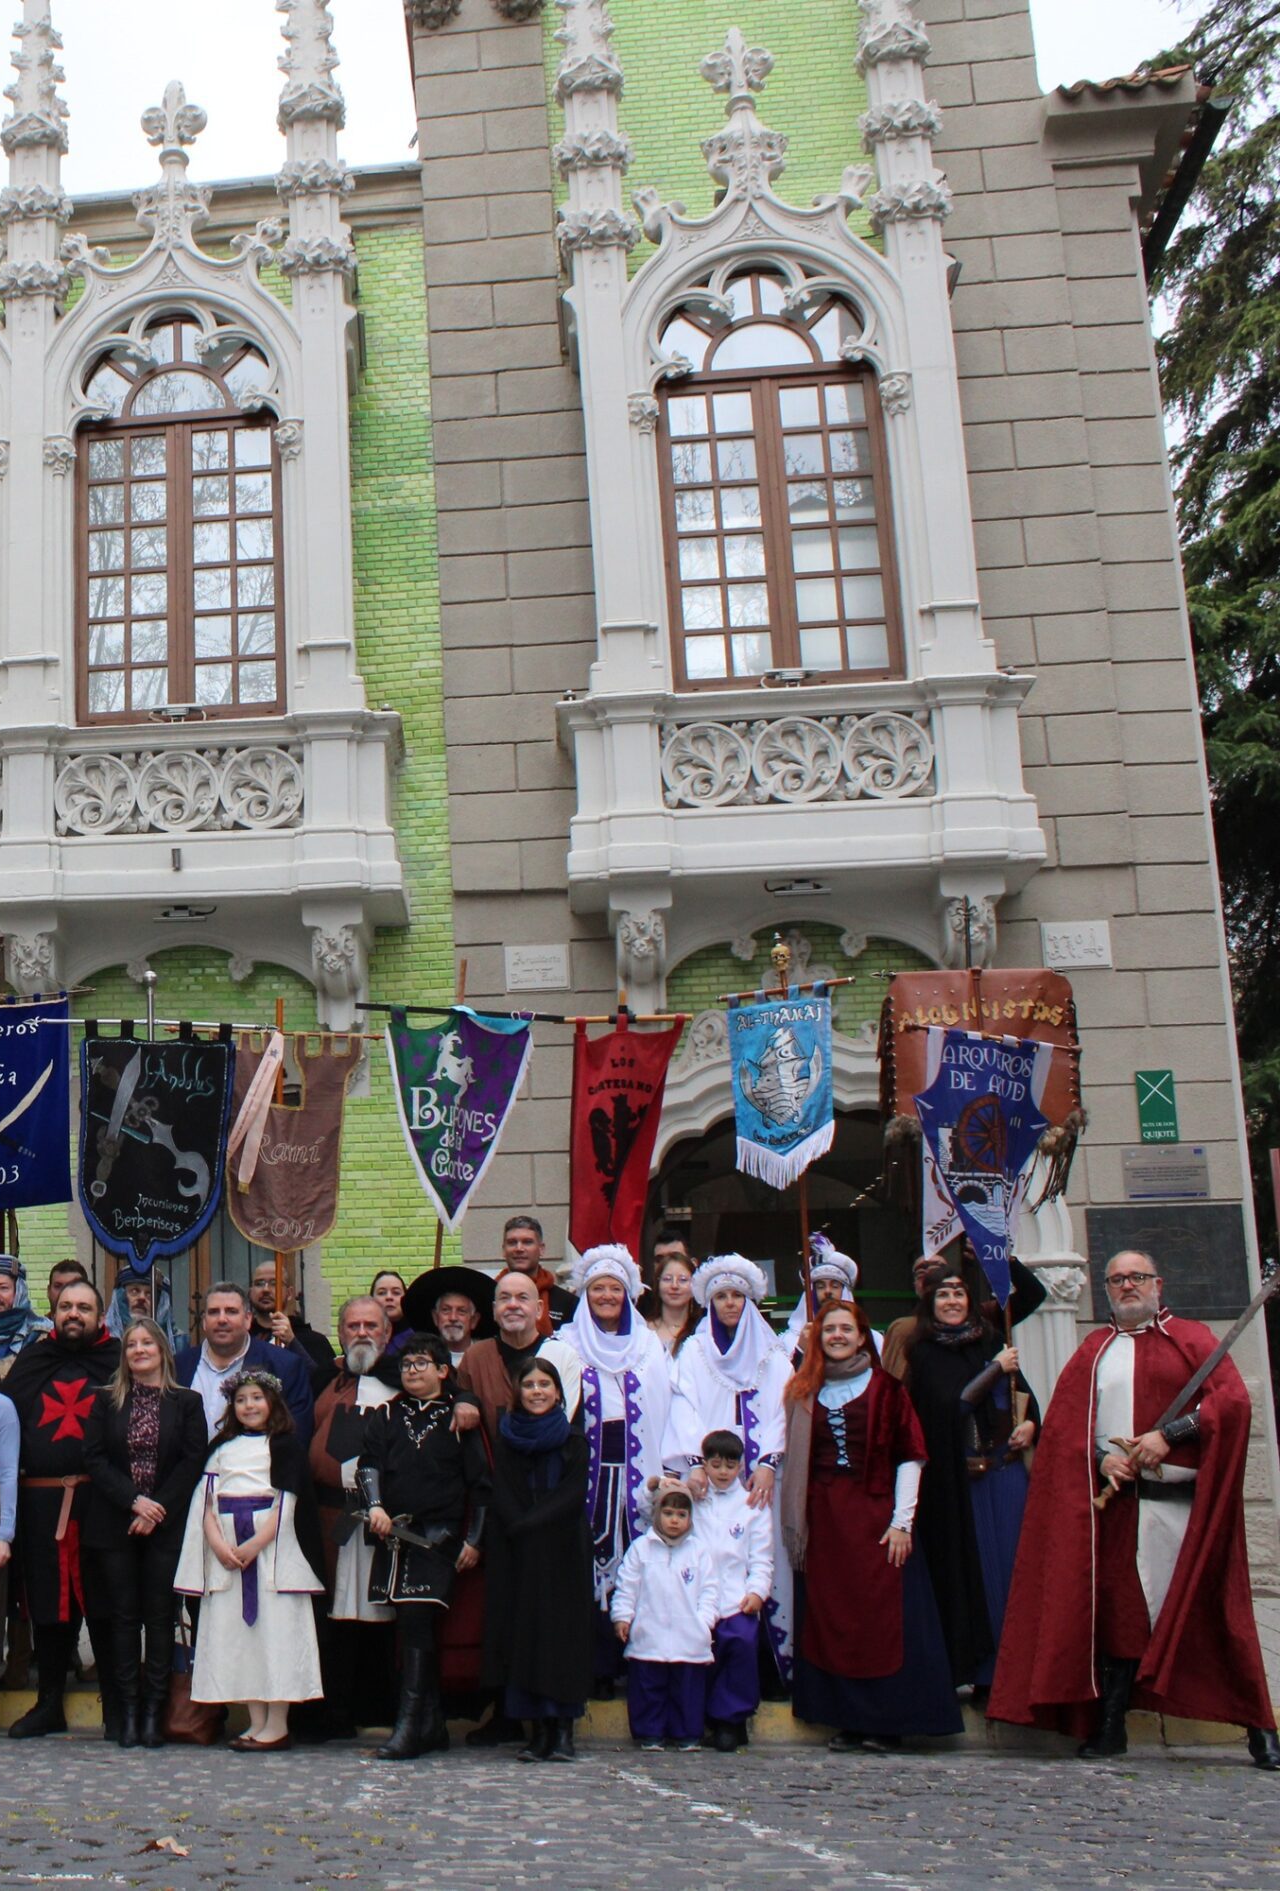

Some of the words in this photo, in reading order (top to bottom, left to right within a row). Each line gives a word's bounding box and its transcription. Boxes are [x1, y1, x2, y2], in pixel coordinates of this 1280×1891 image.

[610, 1056, 635, 1068] LOS
[950, 1070, 976, 1091] DE
[1142, 1130, 1177, 1140] QUIJOTE
